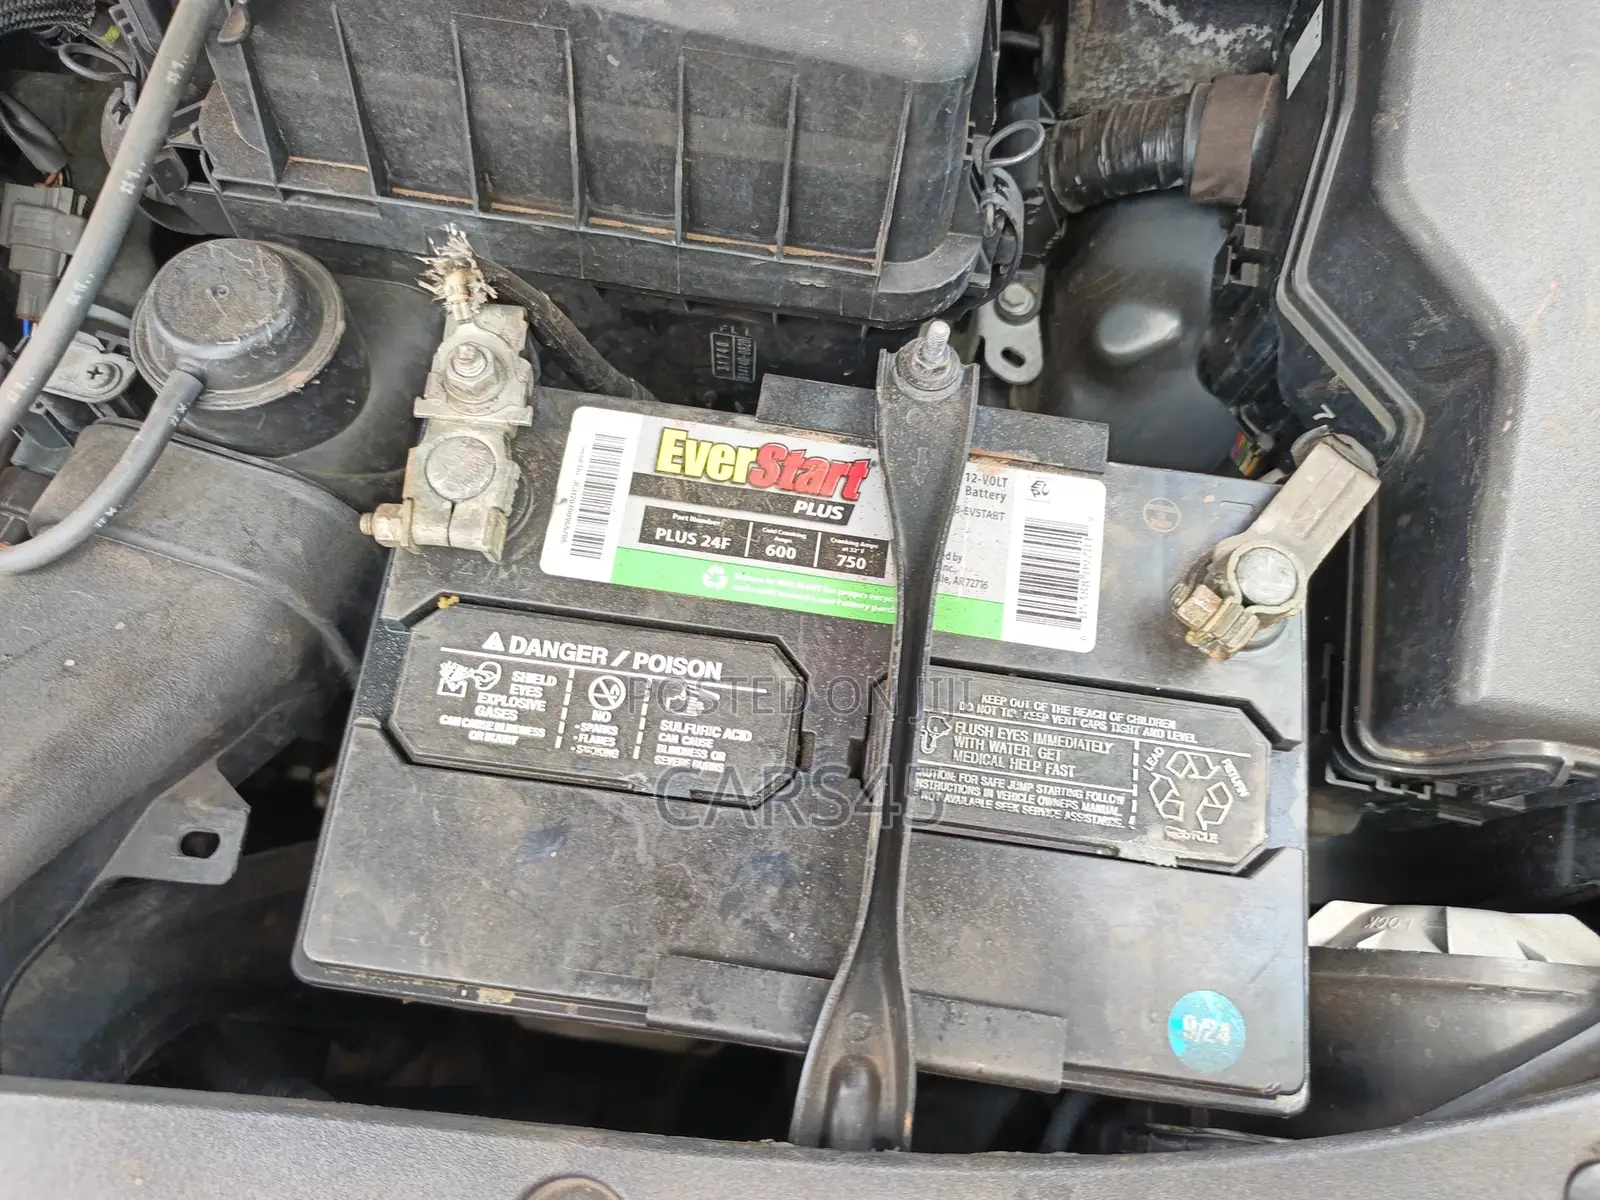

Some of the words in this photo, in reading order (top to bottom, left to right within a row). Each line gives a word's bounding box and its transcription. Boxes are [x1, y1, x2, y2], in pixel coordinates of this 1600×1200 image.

[654, 426, 872, 501] EverStart
[965, 472, 1008, 488] 12-VOLT
[965, 485, 1007, 504] Battery
[793, 501, 846, 520] PLUS
[654, 527, 698, 546] PLUS
[699, 534, 732, 550] 24F
[765, 544, 797, 560] 600
[837, 554, 867, 570] 750
[953, 552, 963, 564] by
[509, 635, 609, 666] DANGER
[632, 651, 723, 681] POISON
[511, 670, 558, 687] SHIELD
[477, 692, 547, 712] EXPLOSIVE
[509, 683, 544, 698] EYES
[474, 705, 519, 721] GASES
[591, 710, 612, 723] NO
[976, 704, 998, 716] NOT
[1023, 711, 1050, 722] KEEP
[1052, 714, 1078, 727] VENT
[1079, 718, 1108, 731] CAPS
[1110, 722, 1141, 736] TIGHT
[1141, 727, 1166, 739] AND
[981, 694, 1007, 706] KEEP
[1009, 697, 1031, 709] OUT
[1033, 700, 1049, 712] OF
[1050, 704, 1072, 716] THE
[1073, 706, 1108, 721] REACH
[1109, 711, 1125, 722] OF
[1126, 713, 1177, 730] CHILDREN
[659, 719, 723, 738] SULFURIC
[722, 728, 753, 742] ACID
[954, 721, 994, 739] FLUSH
[997, 726, 1030, 742] EYES
[1032, 731, 1114, 754] IMMEDIATELY
[953, 735, 984, 751] WITH
[1037, 746, 1062, 762] GET
[1142, 746, 1165, 772] LEAD
[952, 749, 1005, 768] MEDICAL
[1009, 757, 1041, 773] HELP
[1044, 762, 1077, 778] FAST
[958, 772, 979, 785] FOR
[980, 775, 1005, 789] SAFE
[1007, 778, 1035, 793] JUMP
[1035, 784, 1085, 800] STARTING
[1085, 790, 1126, 806] FOLLOW
[1221, 758, 1250, 798] RETURN
[943, 793, 993, 810] AVAILABLE
[994, 800, 1020, 813] SEEK
[1021, 804, 1062, 820] SERVICE
[983, 788, 994, 799] IN
[996, 789, 1036, 804] VEHICLE
